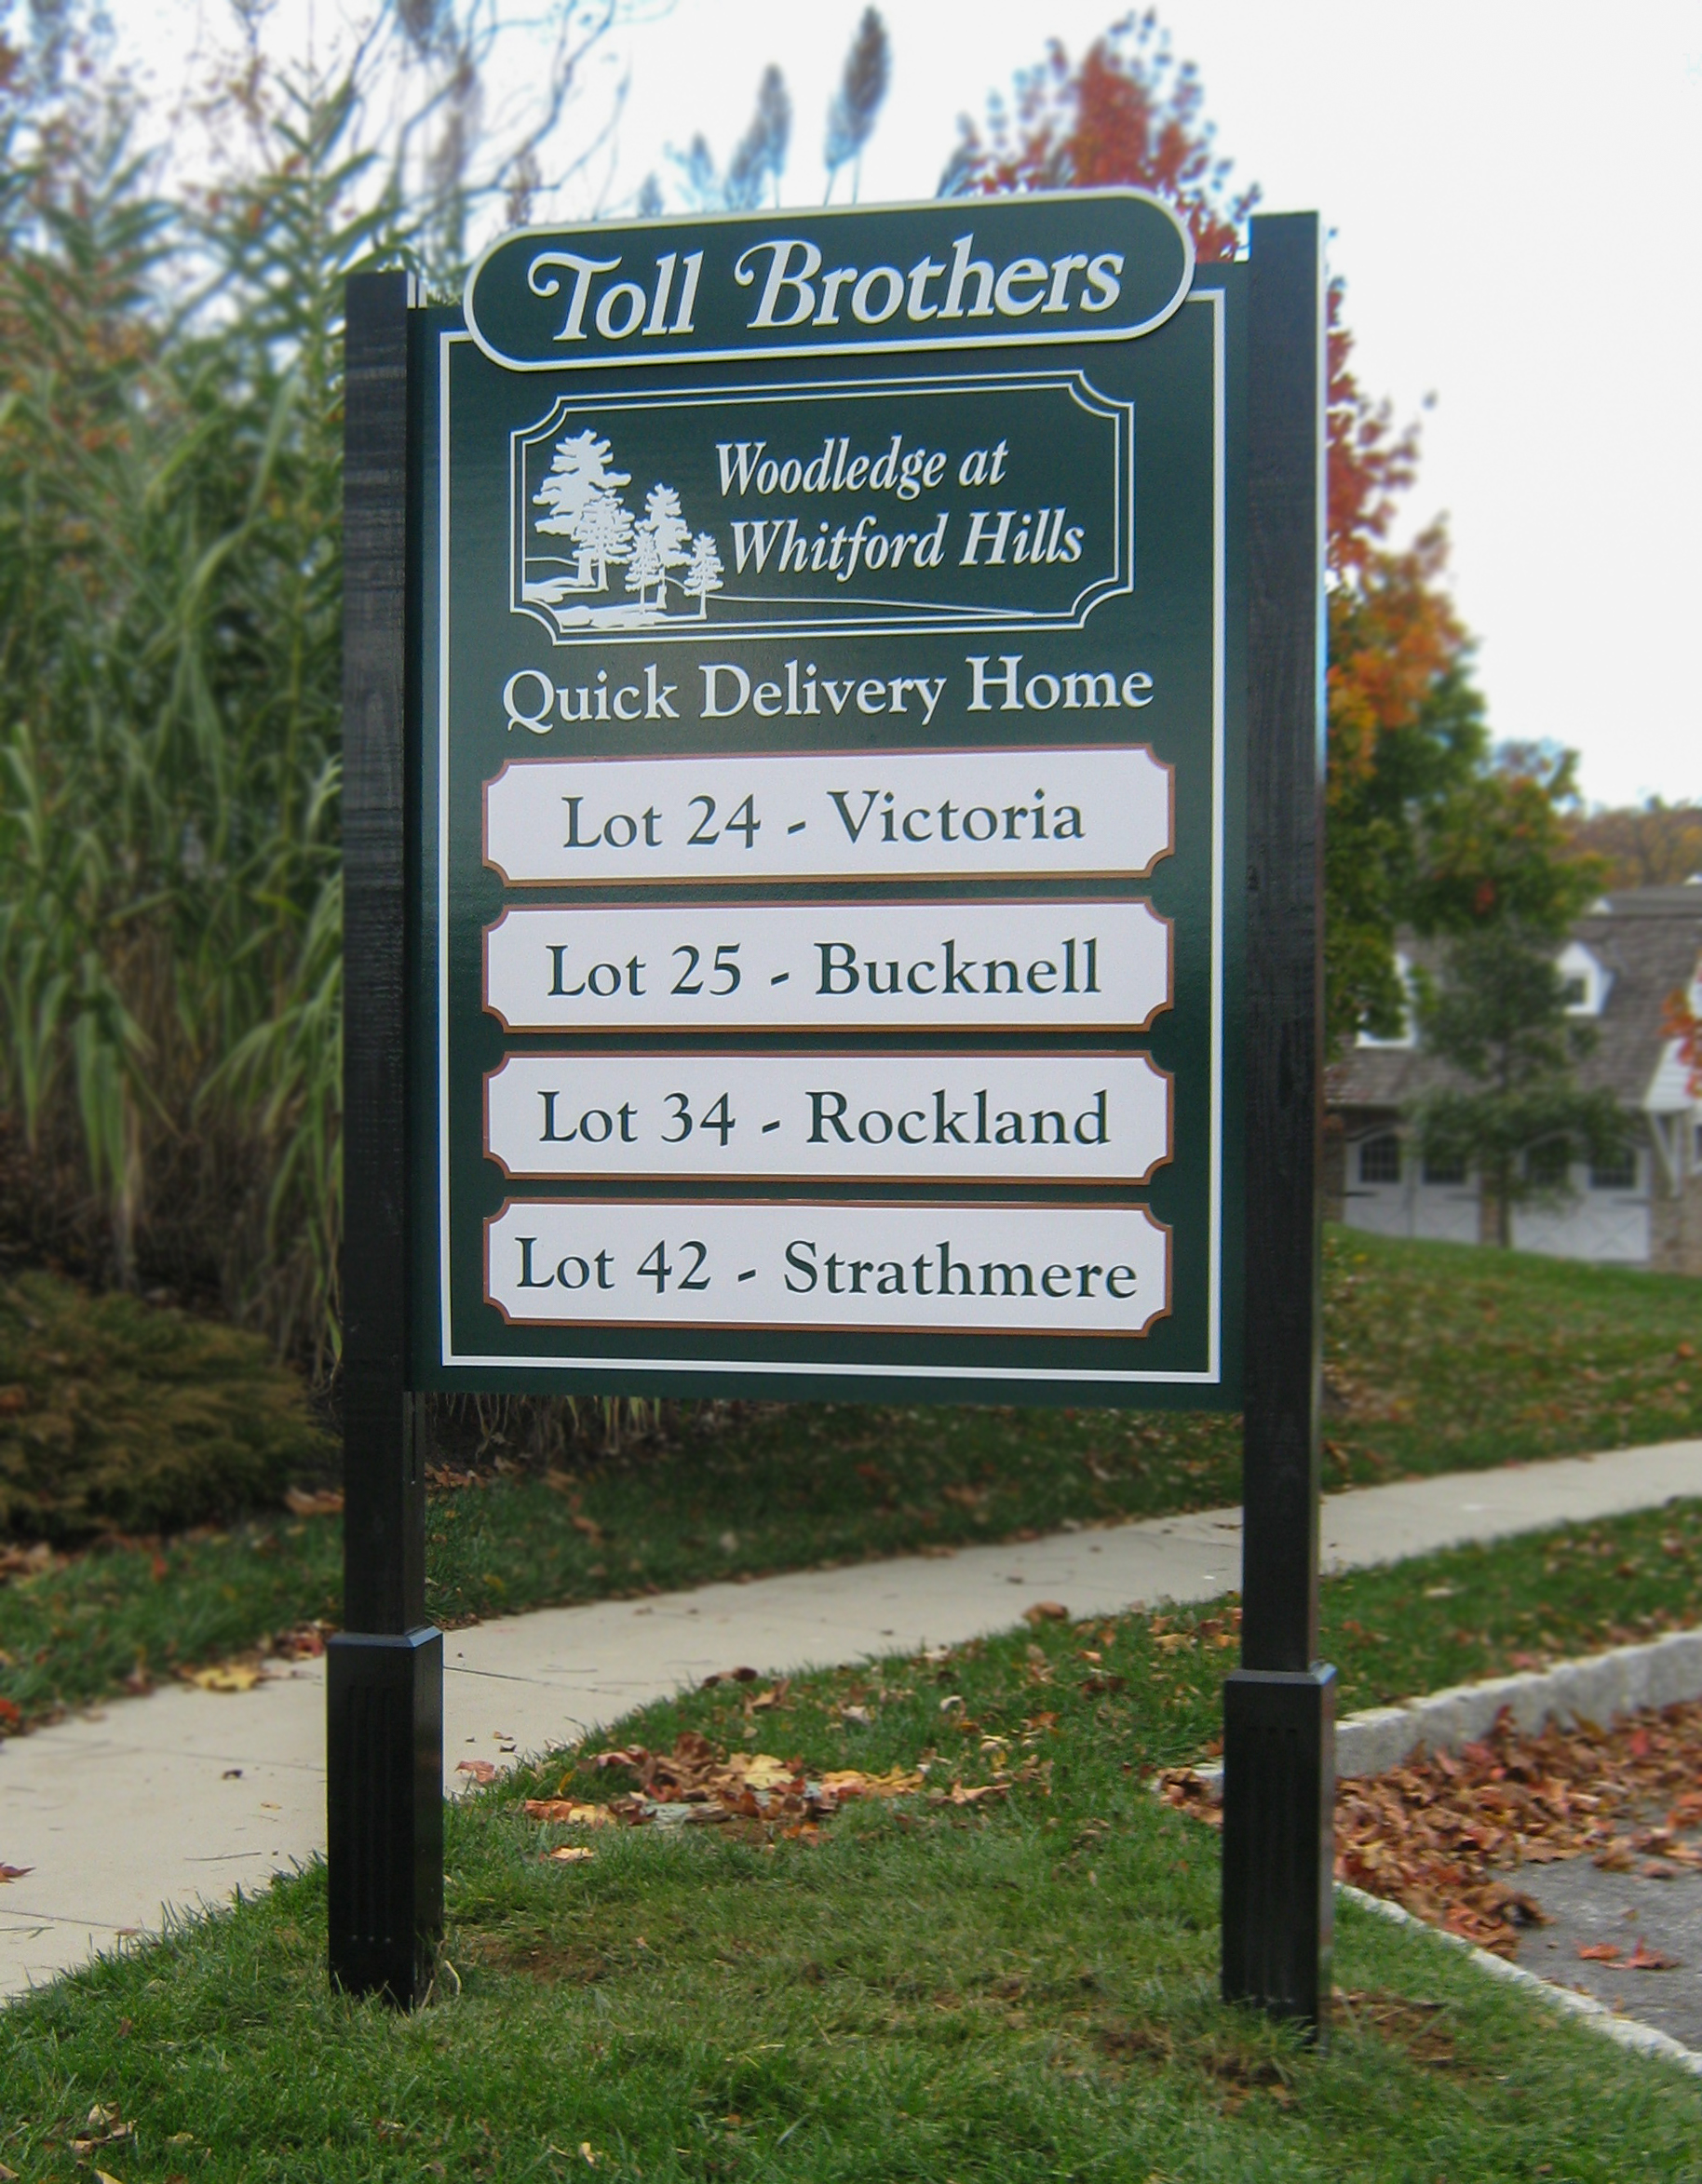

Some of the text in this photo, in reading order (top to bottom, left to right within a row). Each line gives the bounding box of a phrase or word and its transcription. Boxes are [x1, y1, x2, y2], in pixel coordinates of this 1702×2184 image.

[527, 233, 1125, 341] Toll Brothers
[715, 436, 1009, 500] Woodledge at
[730, 507, 1085, 582] Whitford Hills
[503, 654, 1154, 734] Quick Delivery Home
[561, 788, 1086, 849] Lot 24 - Victoria
[545, 937, 1101, 997] Lot 25 - Bucknell
[536, 1088, 1111, 1147] Lot 34 - Rockland
[514, 1236, 1137, 1299] Lot 42 - Strathmere
